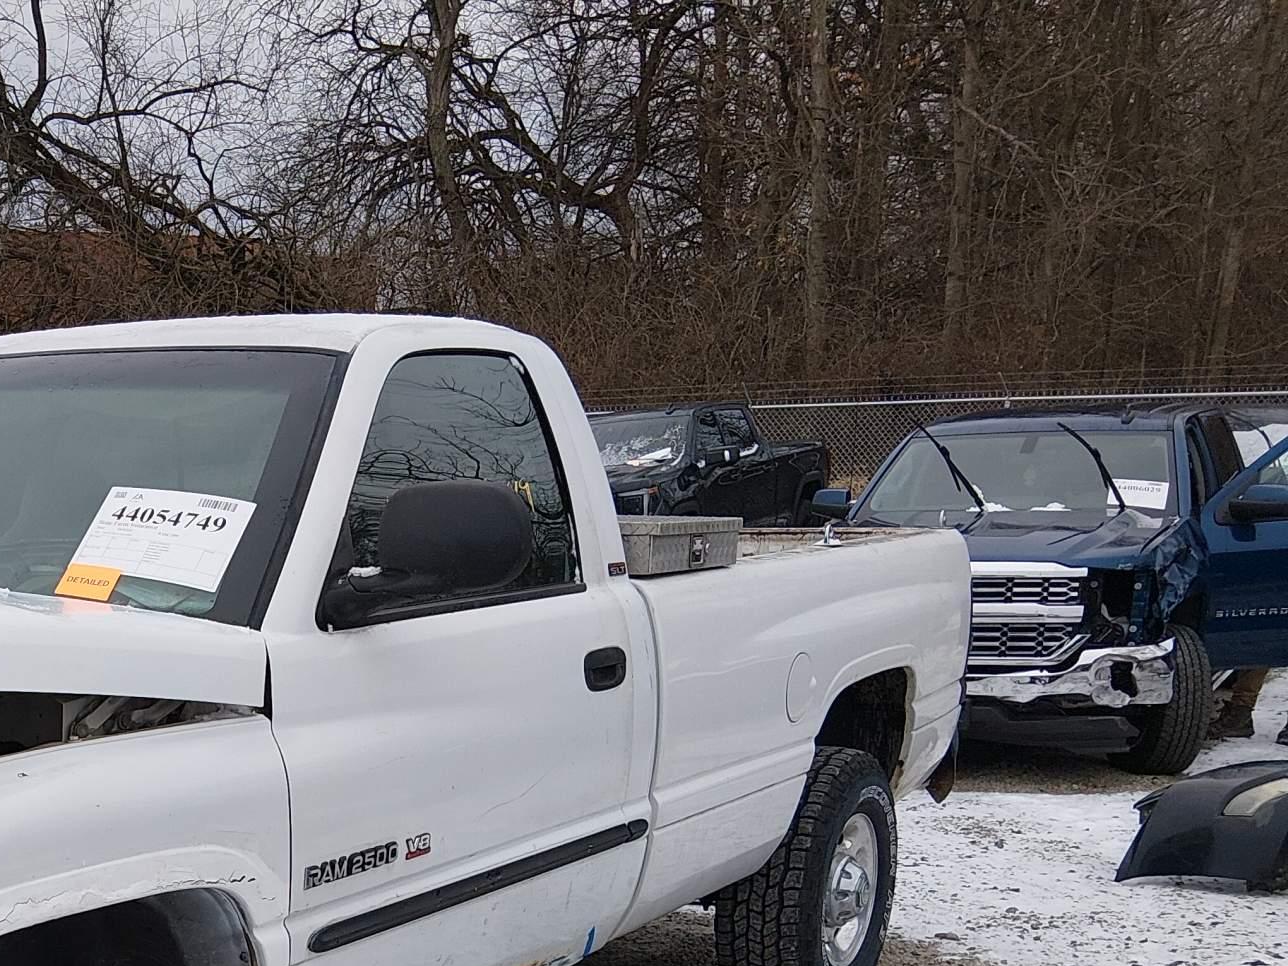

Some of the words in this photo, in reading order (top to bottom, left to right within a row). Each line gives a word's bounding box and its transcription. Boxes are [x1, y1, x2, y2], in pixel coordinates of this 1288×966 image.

[111, 505, 227, 533] 44054749
[66, 576, 110, 587] DETAILED
[405, 833, 432, 853] V8
